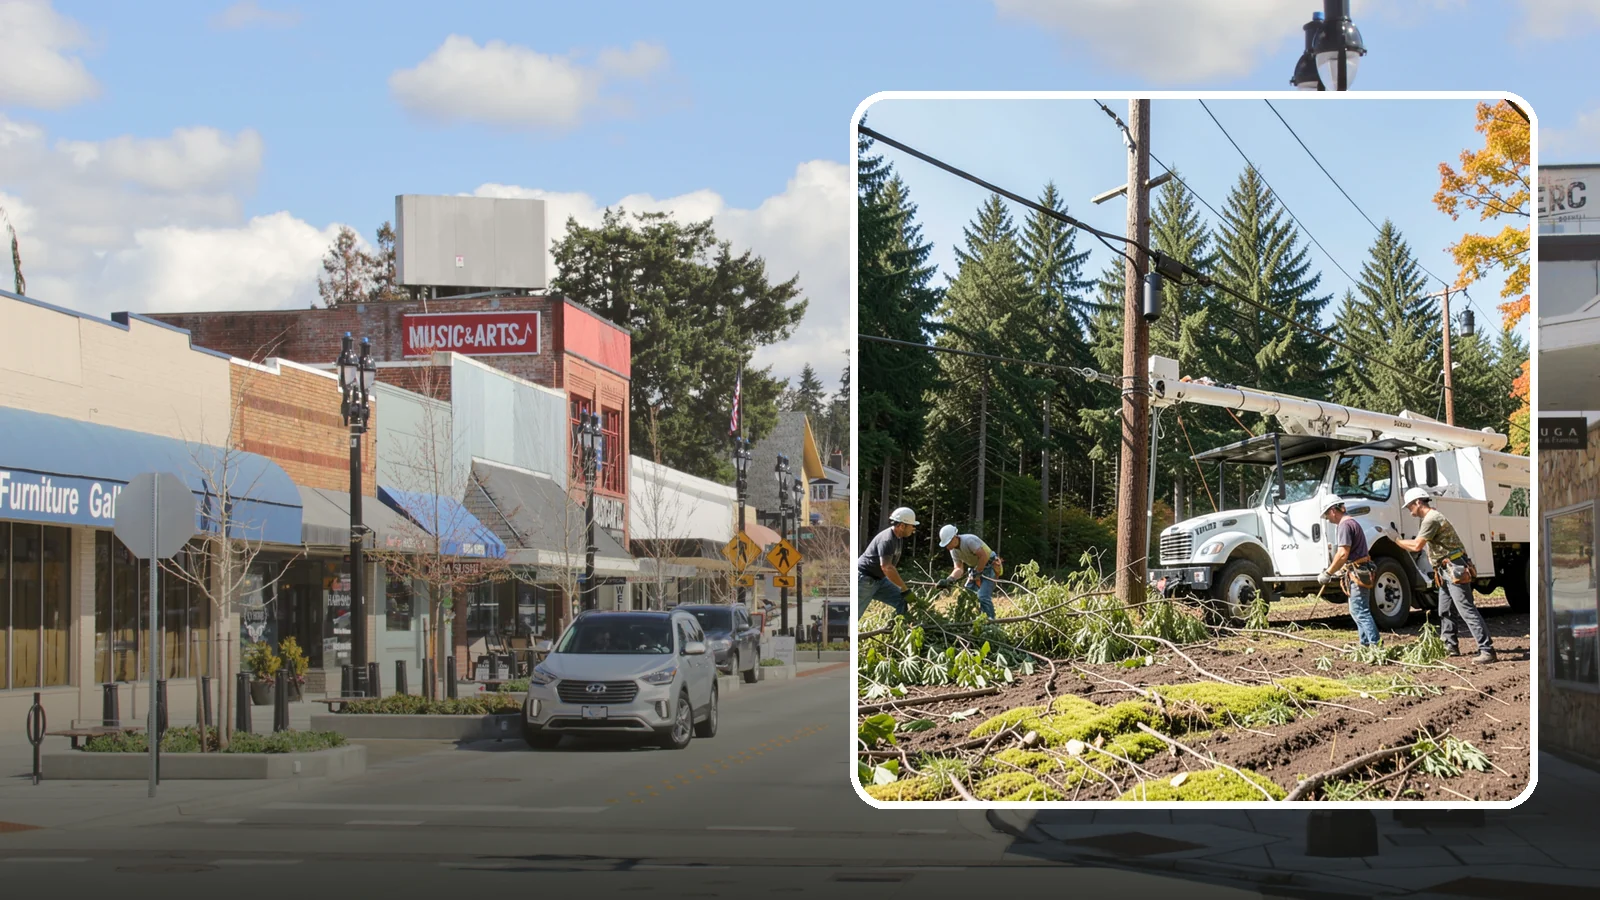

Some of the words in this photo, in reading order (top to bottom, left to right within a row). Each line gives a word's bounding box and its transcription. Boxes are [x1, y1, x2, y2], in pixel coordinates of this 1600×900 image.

[409, 323, 519, 348] MUSIC&ARTS
[0, 472, 79, 515] Furniture
[89, 483, 121, 518] Gal
